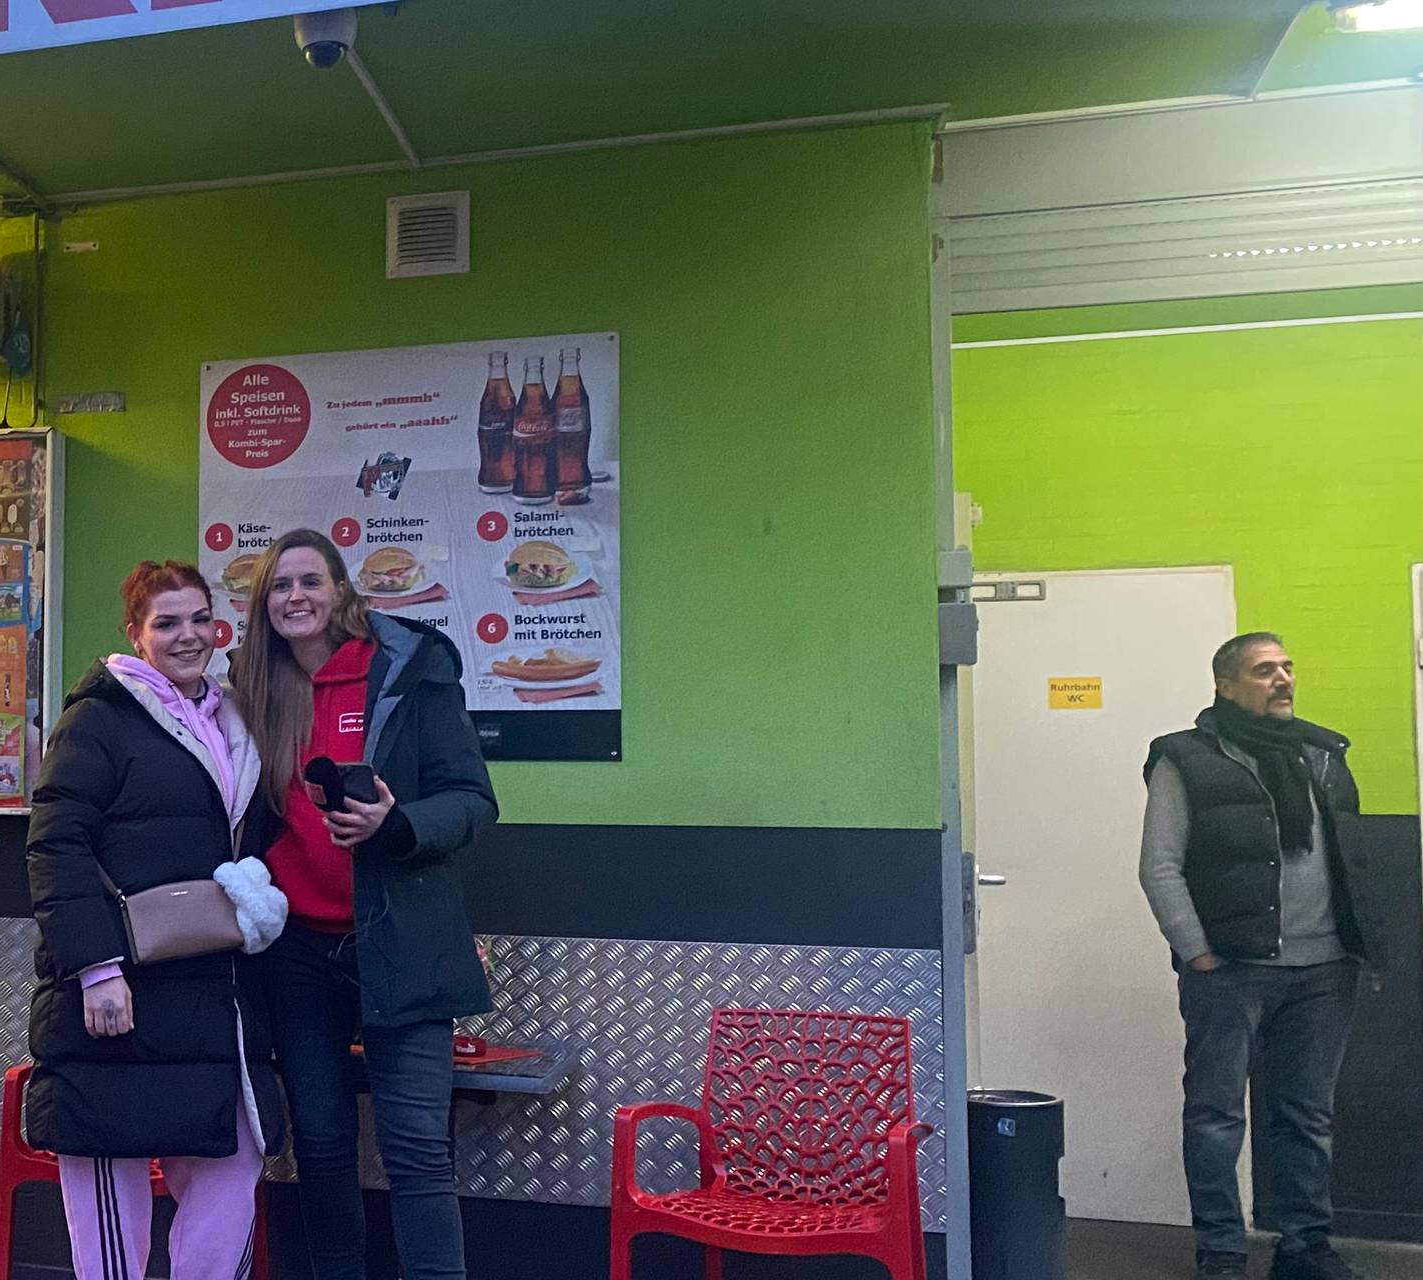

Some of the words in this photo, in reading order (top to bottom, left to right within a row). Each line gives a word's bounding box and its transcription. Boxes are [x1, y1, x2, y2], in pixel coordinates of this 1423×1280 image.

[242, 374, 270, 386] Alle
[230, 391, 285, 405] Speisen
[215, 408, 241, 419] inkl.
[244, 404, 301, 418] Softdrink
[247, 429, 268, 437] zum
[228, 438, 286, 449] Kombi-Spar-
[245, 450, 270, 458] Preis
[341, 526, 350, 538] 2
[366, 516, 430, 530] Schinken-
[487, 520, 496, 532] 3
[513, 511, 565, 523] Salami-
[216, 532, 223, 542] 1
[238, 522, 272, 534] Käse-
[366, 531, 423, 544] brötchen
[513, 526, 574, 538] brötchen
[487, 622, 497, 634] 6
[514, 613, 586, 625] Bockwurst
[215, 628, 224, 639] 4
[514, 630, 537, 641] mit
[541, 629, 602, 640] Brötchen
[1050, 683, 1100, 692] Ruhrbahn
[1067, 694, 1085, 703] WC
